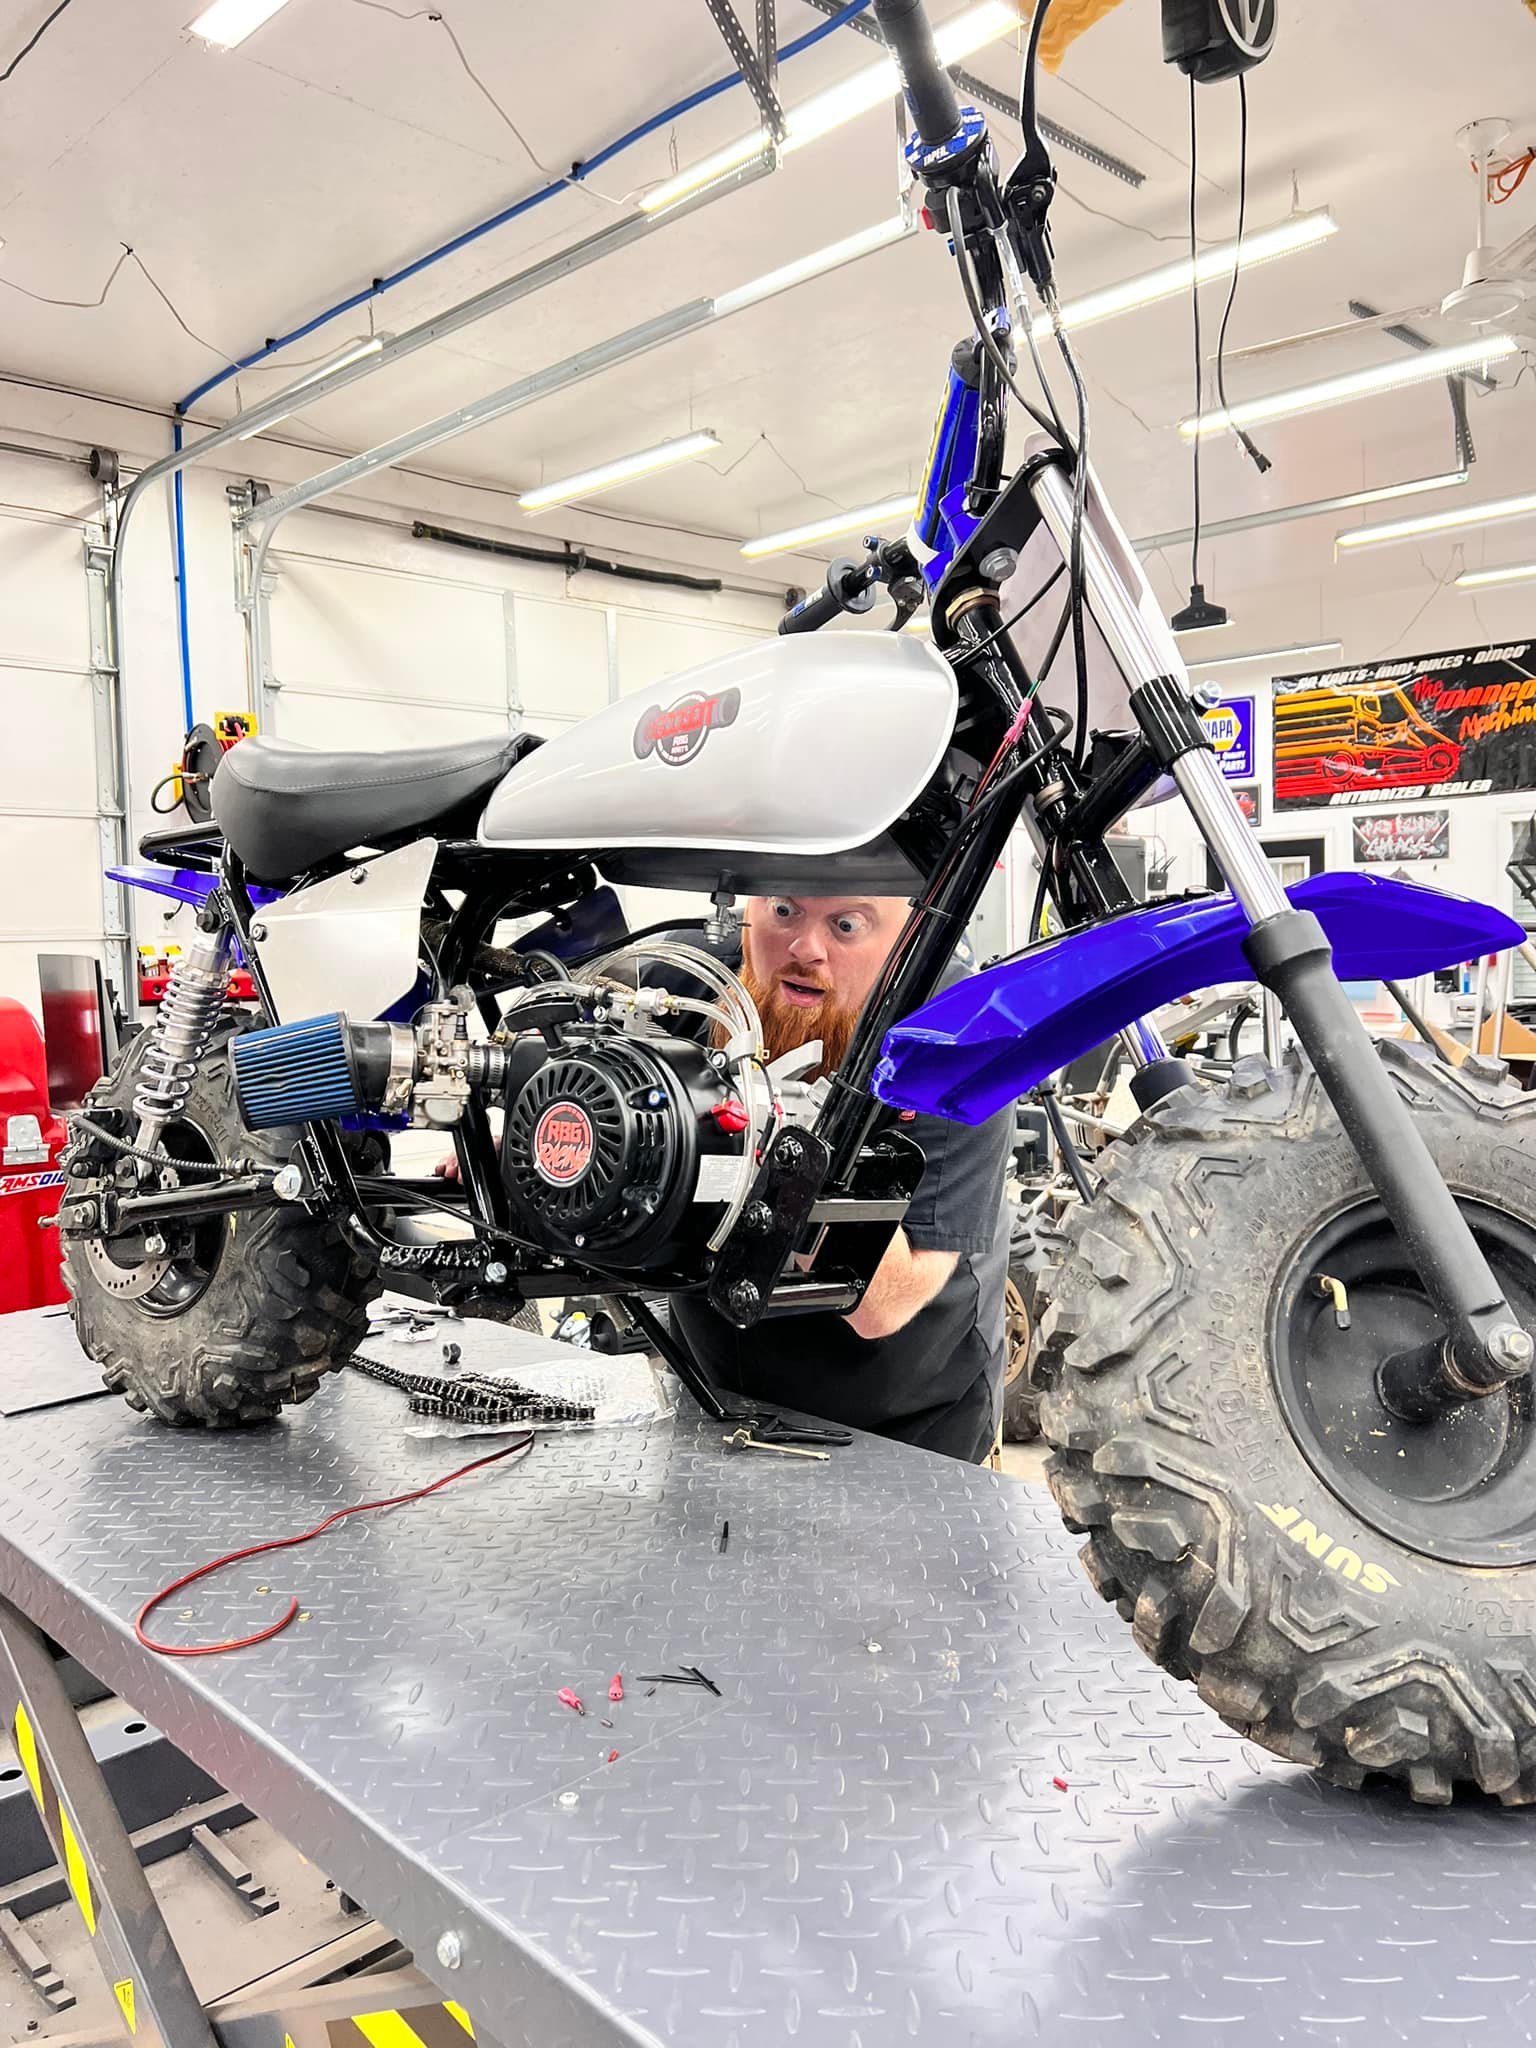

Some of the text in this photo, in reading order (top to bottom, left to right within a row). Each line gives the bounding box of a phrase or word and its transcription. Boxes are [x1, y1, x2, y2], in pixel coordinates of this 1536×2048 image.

[1319, 668, 1369, 687] KARTS
[1412, 675, 1444, 701] the
[1458, 700, 1536, 741] Machin
[1328, 779, 1493, 806] AUTHORIZED DEALER
[547, 1119, 583, 1143] RBG
[0, 1173, 64, 1192] AMSOIL
[1254, 1500, 1402, 1593] SUNF
